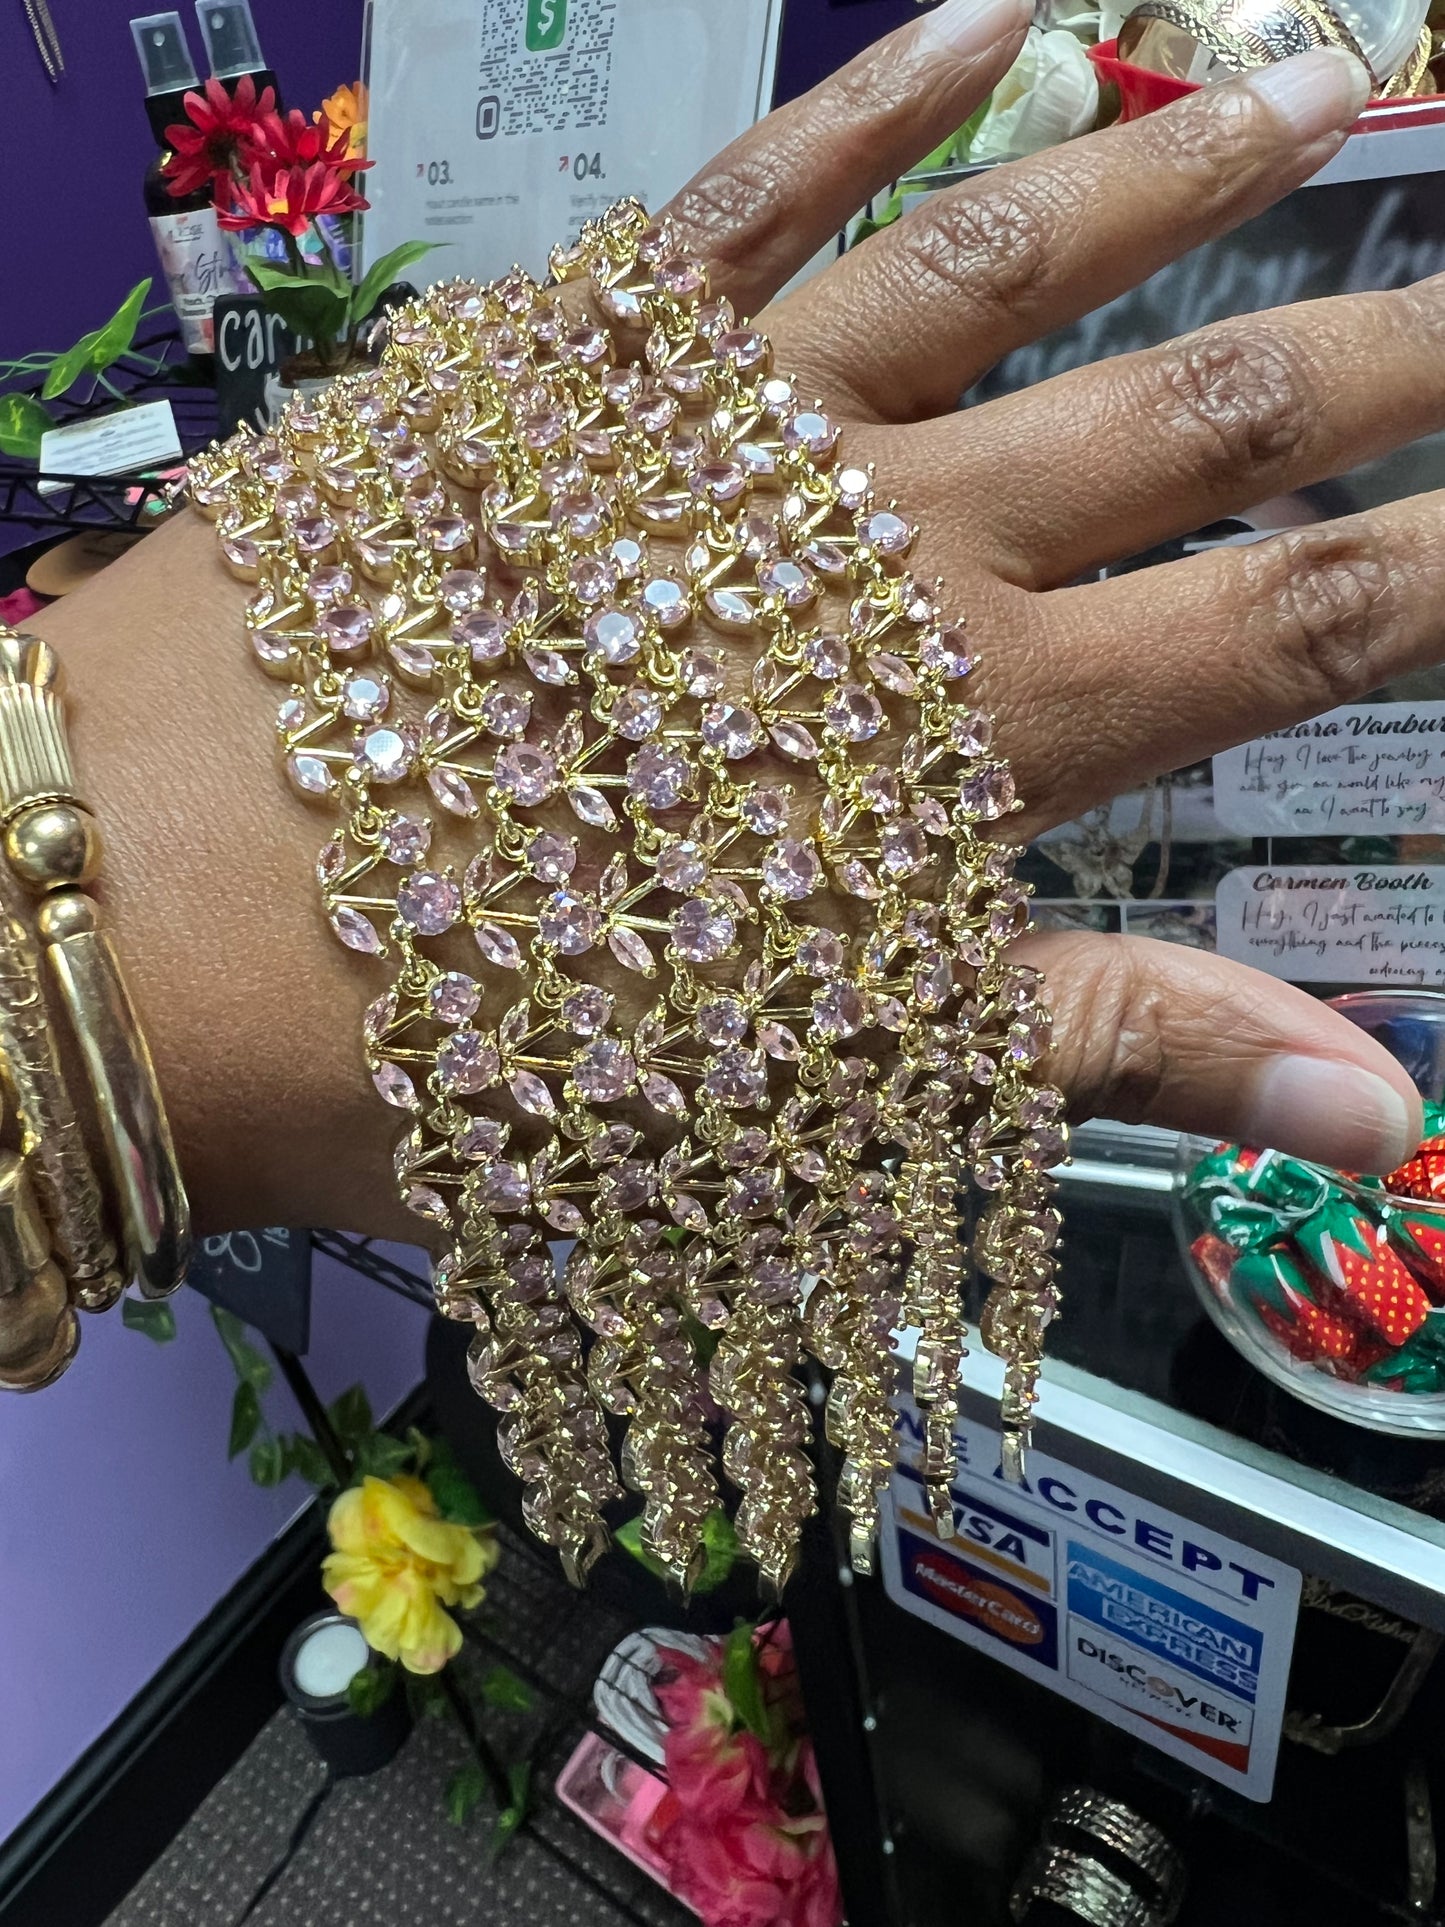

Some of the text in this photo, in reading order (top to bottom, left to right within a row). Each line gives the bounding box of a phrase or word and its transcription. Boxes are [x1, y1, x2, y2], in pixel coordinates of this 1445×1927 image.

[427, 160, 454, 185] 03.
[573, 152, 606, 181] 04.
[1253, 872, 1434, 892] Carmen Booth
[914, 1562, 1041, 1635] MasterCard
[1067, 1560, 1254, 1667] AMERICAN
[1102, 1596, 1259, 1695] EXPRESS
[1077, 1636, 1242, 1735] DISCOVER
